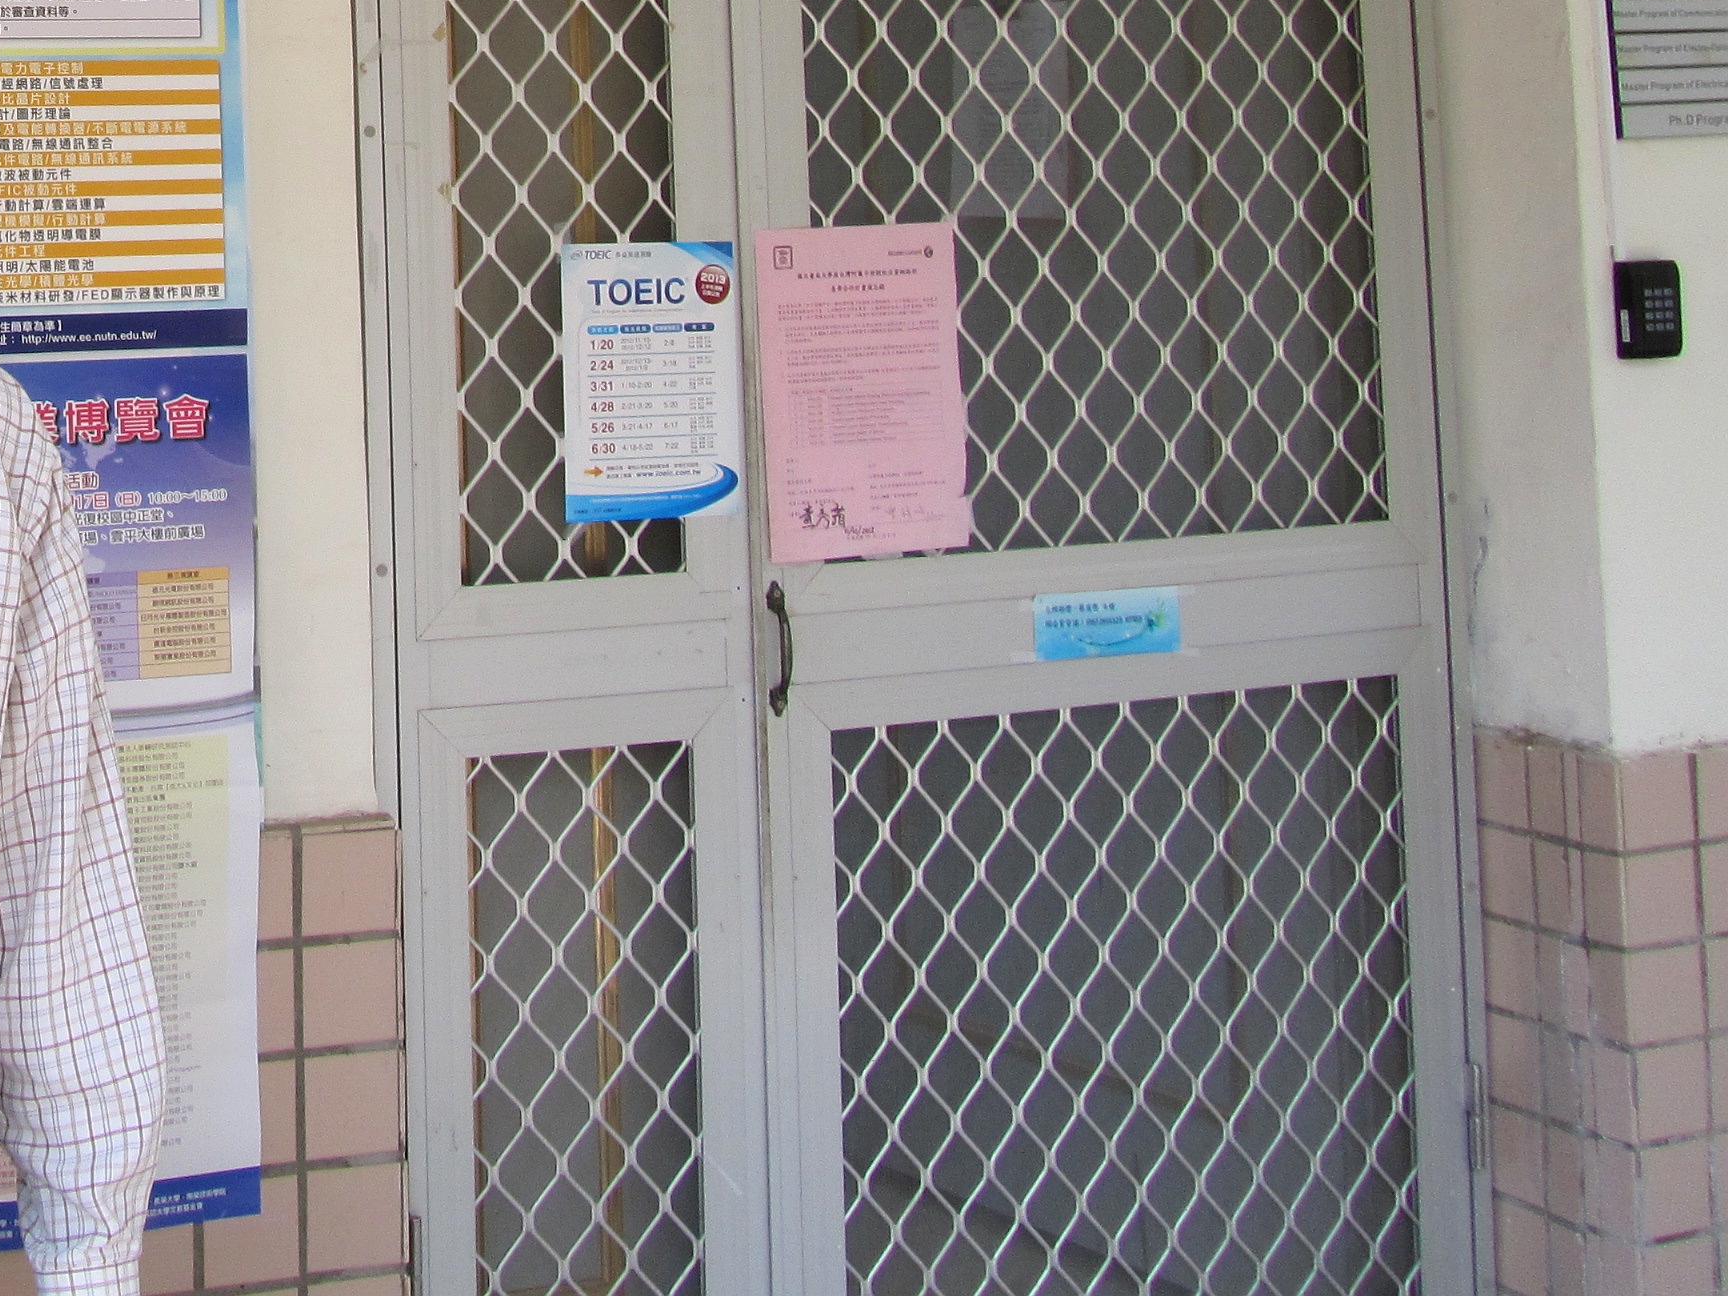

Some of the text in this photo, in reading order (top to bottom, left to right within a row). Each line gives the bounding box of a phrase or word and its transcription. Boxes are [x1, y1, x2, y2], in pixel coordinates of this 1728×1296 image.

[585, 250, 611, 259] TOEIC
[700, 273, 725, 283] 2013
[587, 278, 685, 305] TOEIC
[21, 330, 157, 345] http://www.ee.nutn.edu.tw/
[590, 339, 614, 350] 1/20
[590, 360, 614, 370] 2/24
[590, 381, 613, 392] 3/31
[591, 402, 614, 412] 4/28
[591, 422, 614, 433] 5/26
[592, 443, 616, 454] 6/30
